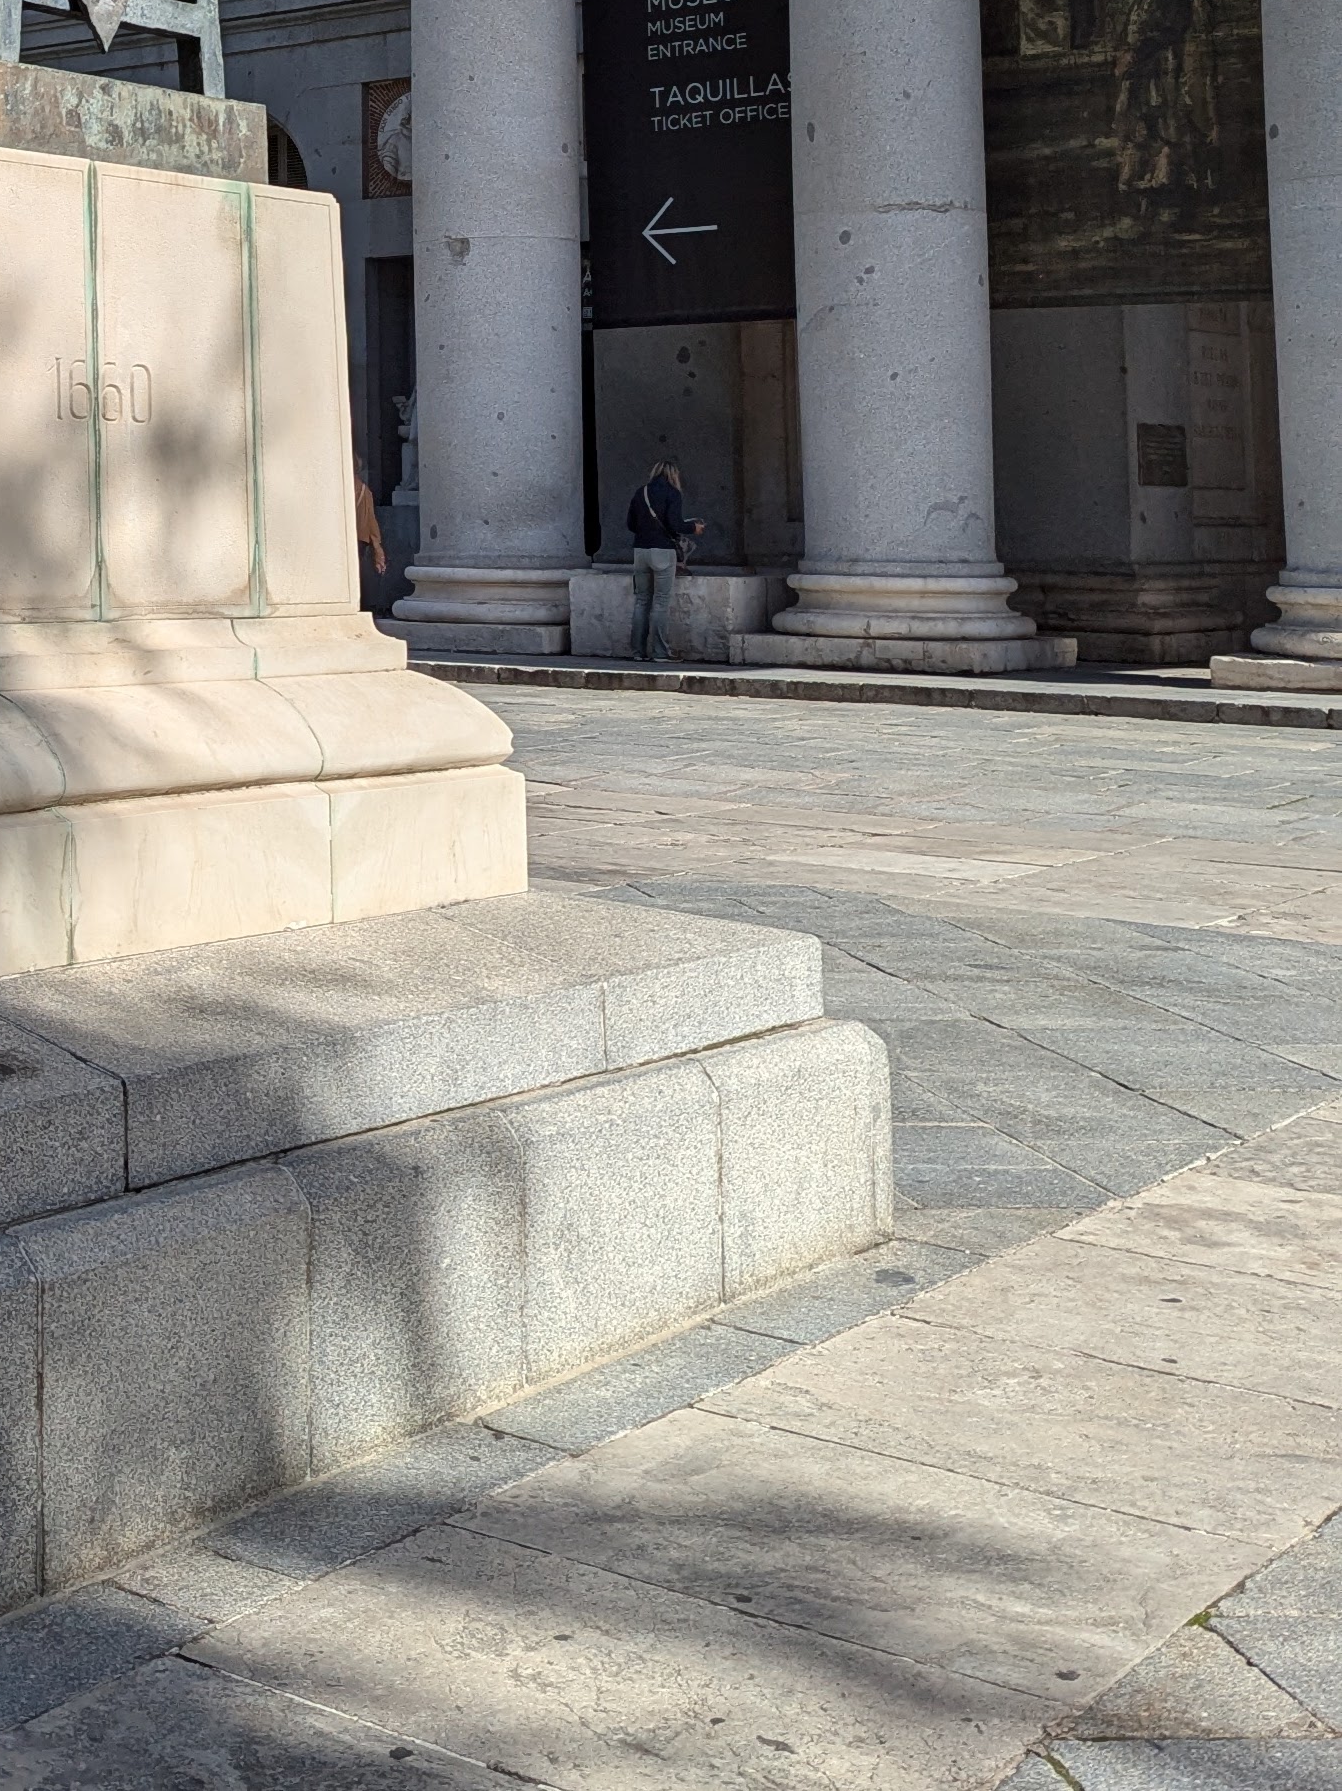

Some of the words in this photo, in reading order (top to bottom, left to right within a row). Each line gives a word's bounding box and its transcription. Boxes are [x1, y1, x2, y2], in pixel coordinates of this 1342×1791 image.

[647, 11, 724, 36] MUSEUM
[647, 33, 747, 60] ENTRANCE
[651, 110, 714, 132] TICKET
[719, 102, 790, 124] OFFICE
[46, 356, 153, 425] 1660
